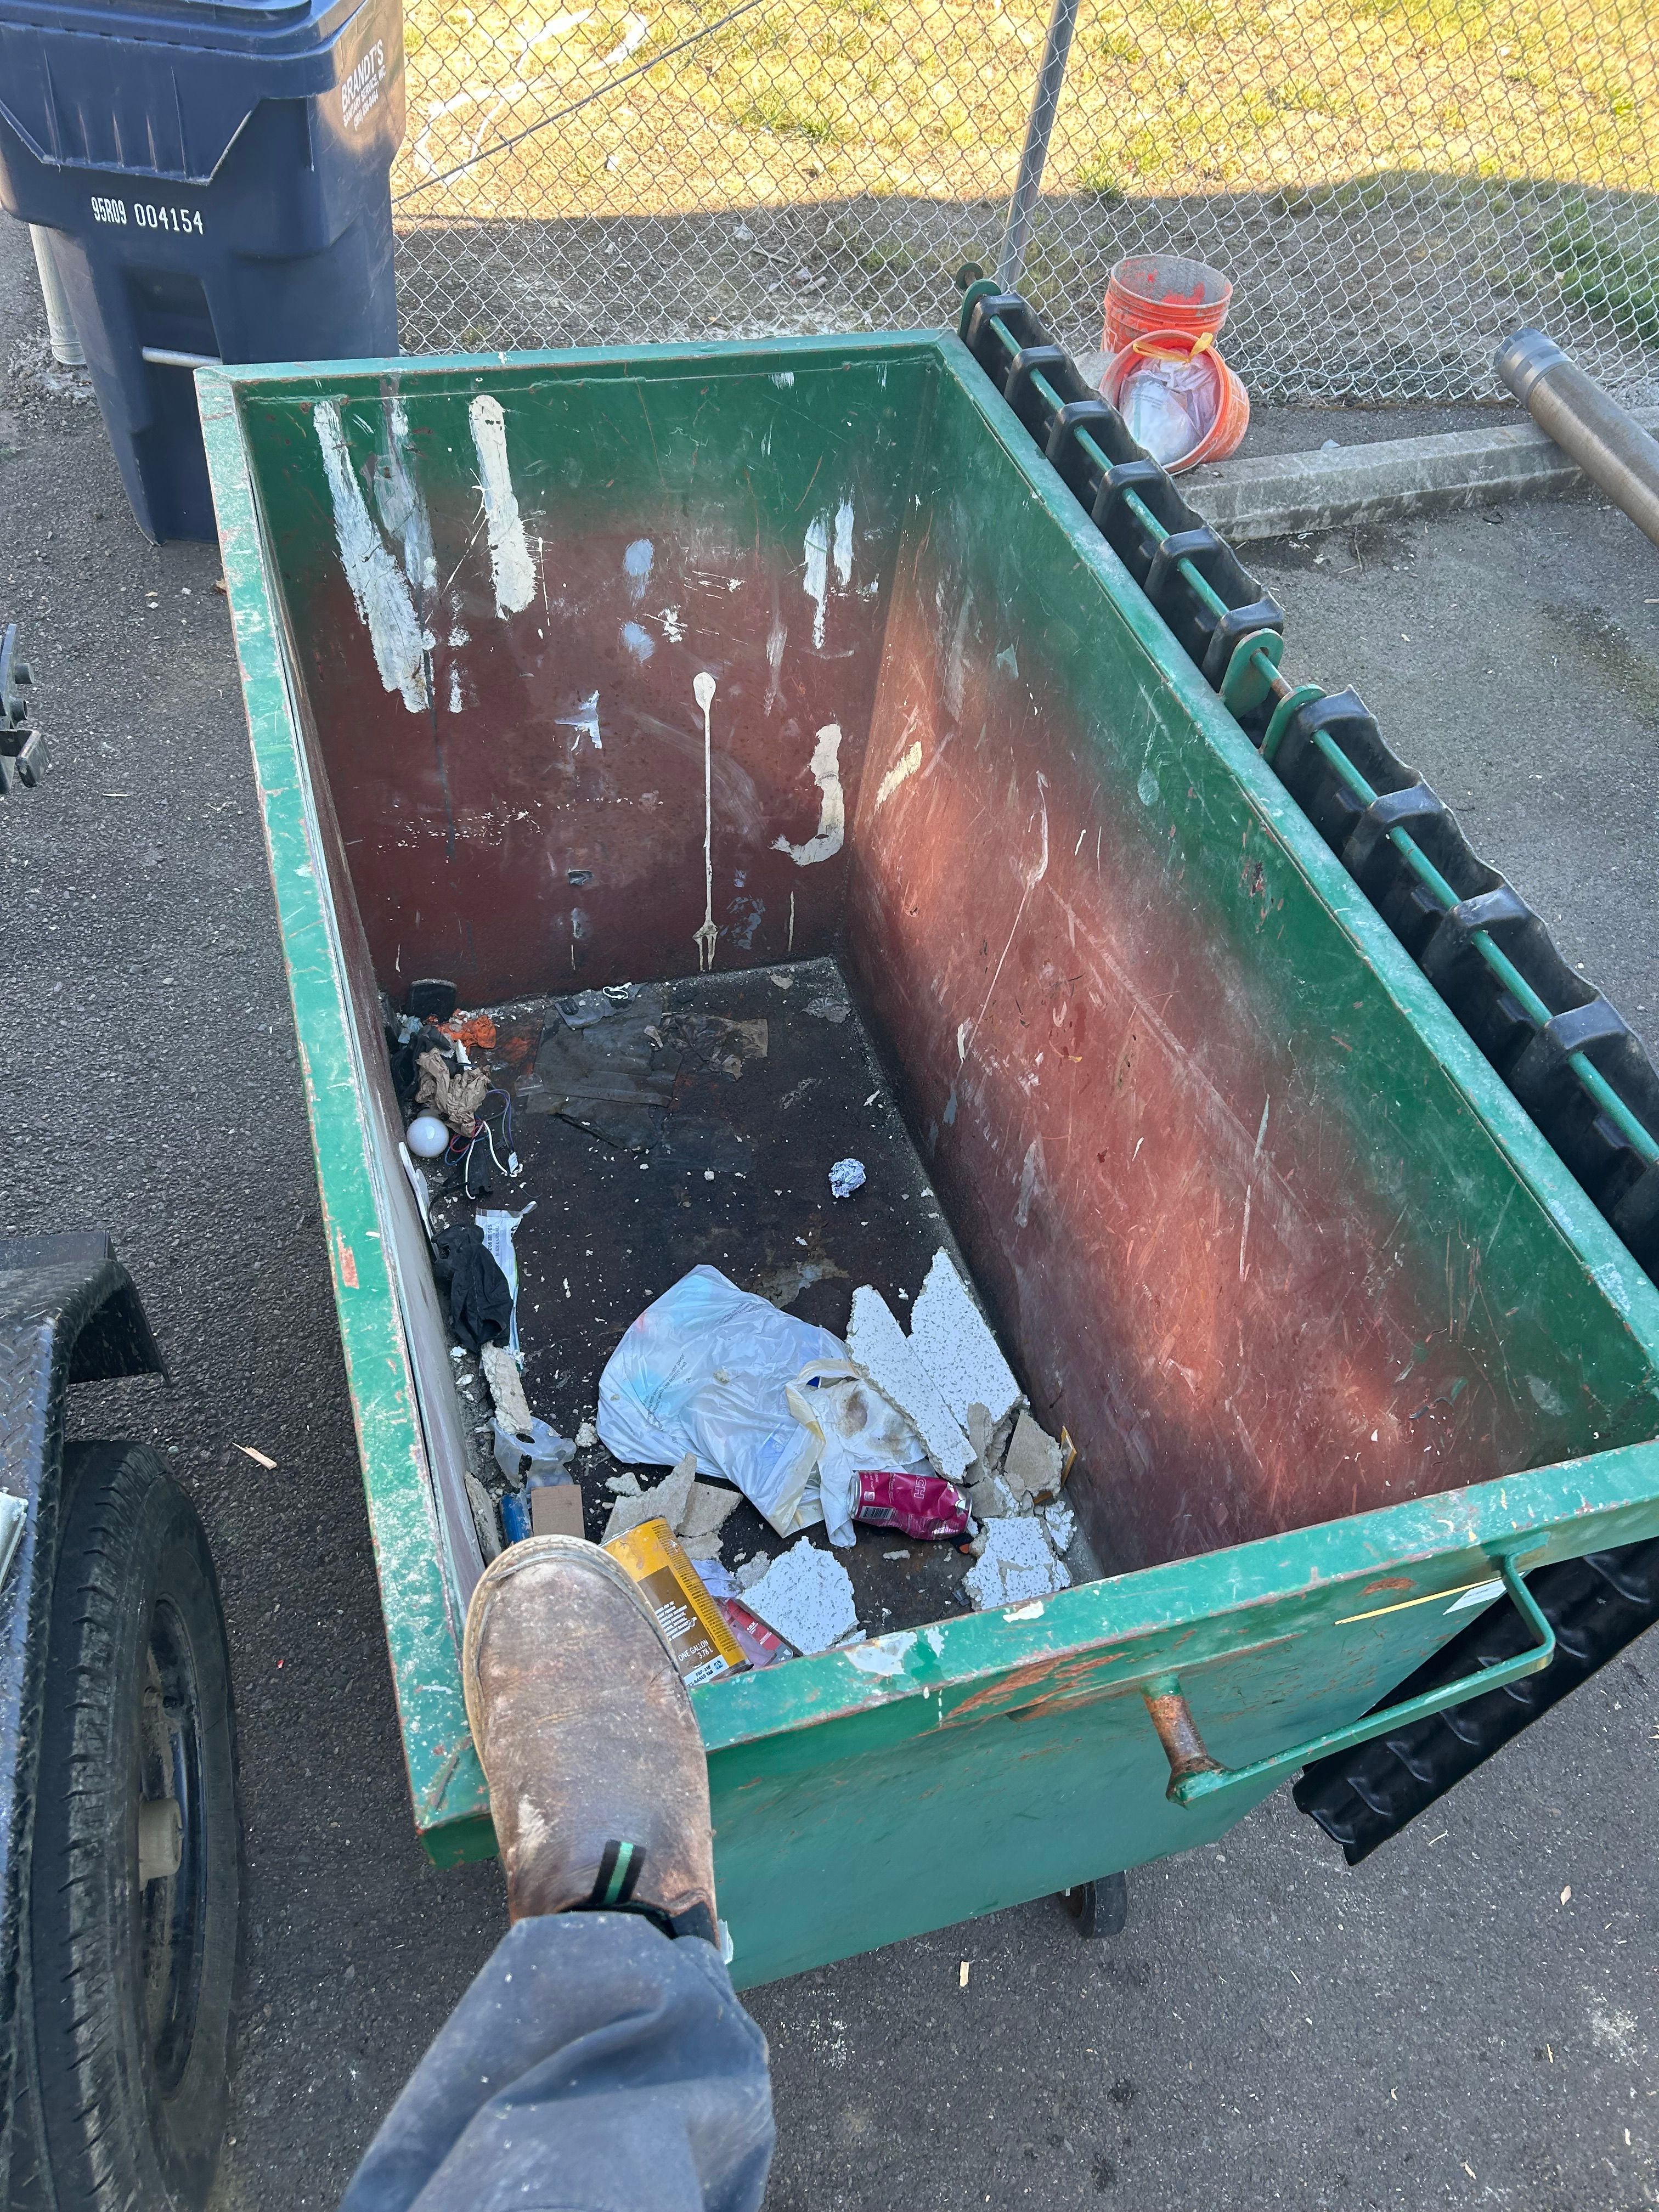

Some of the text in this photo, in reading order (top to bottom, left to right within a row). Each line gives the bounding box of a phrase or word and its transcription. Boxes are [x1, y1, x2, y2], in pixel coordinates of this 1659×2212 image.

[341, 39, 383, 113] BRANDT'S
[343, 93, 361, 128] SANITARY
[378, 64, 386, 81] INC
[91, 196, 203, 235] 95R09 004154
[678, 1639, 709, 1661] ONE GALLON
[697, 1647, 709, 1659] 3.78
